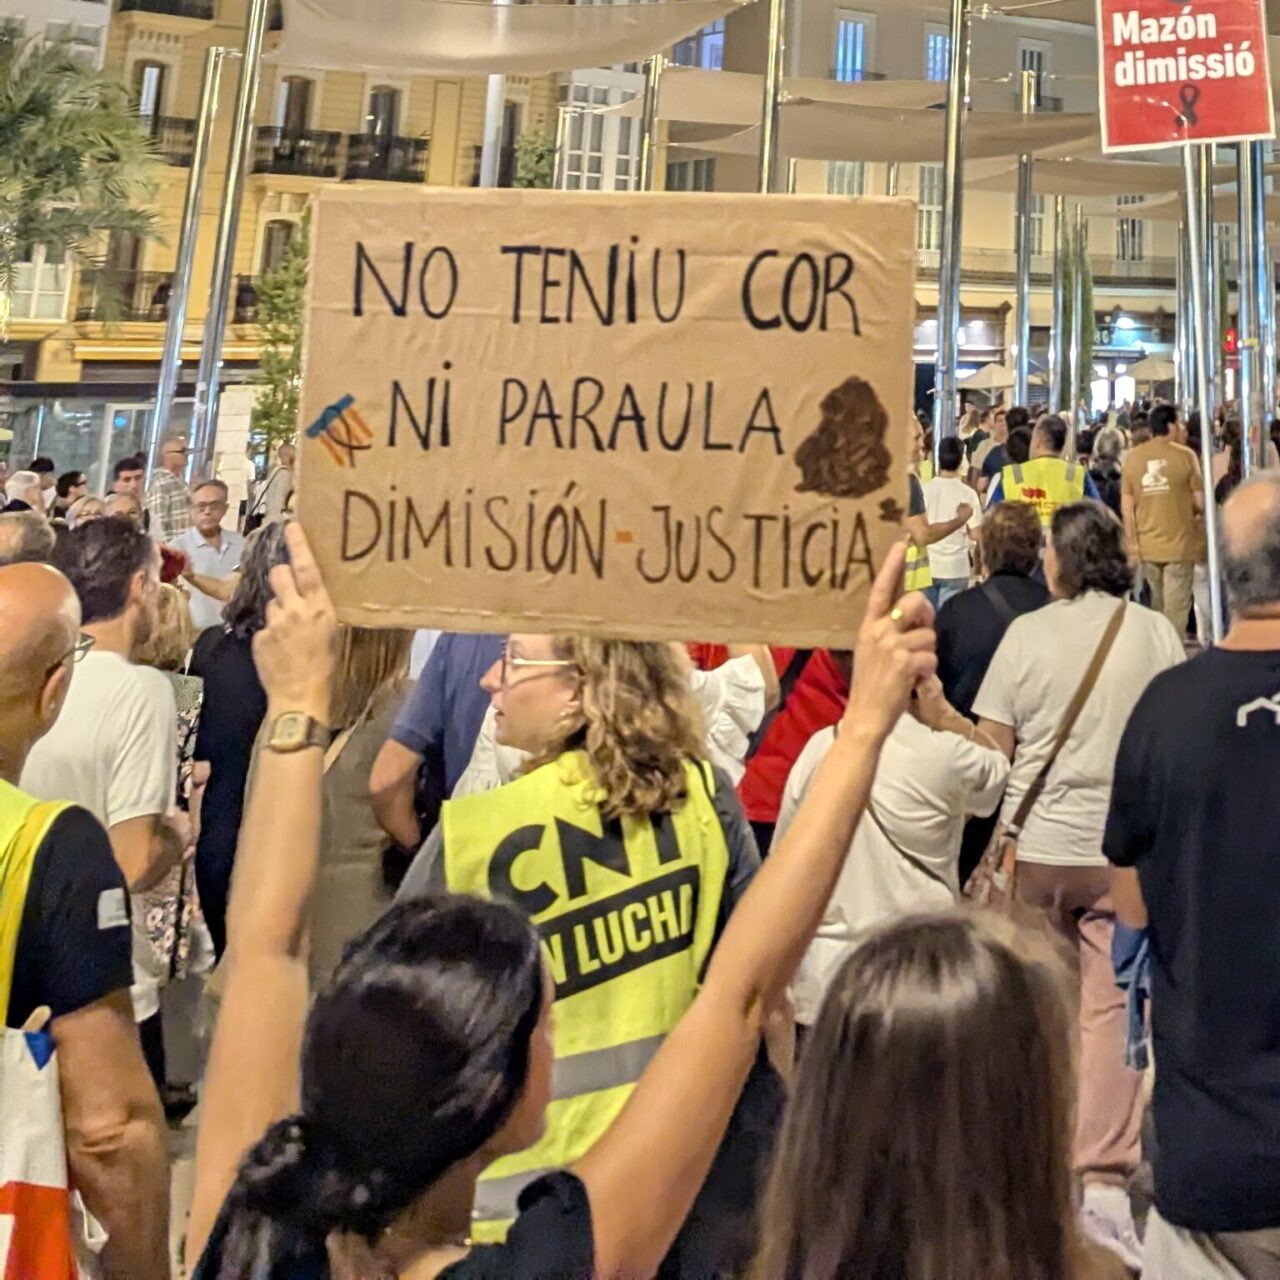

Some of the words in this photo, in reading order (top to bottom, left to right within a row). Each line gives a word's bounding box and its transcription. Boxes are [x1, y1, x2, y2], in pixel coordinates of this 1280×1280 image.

[1111, 6, 1217, 47] Mazón
[1114, 40, 1256, 87] dimissió
[353, 239, 460, 320] NO
[742, 249, 863, 337] COR
[499, 376, 784, 456] PARAULA
